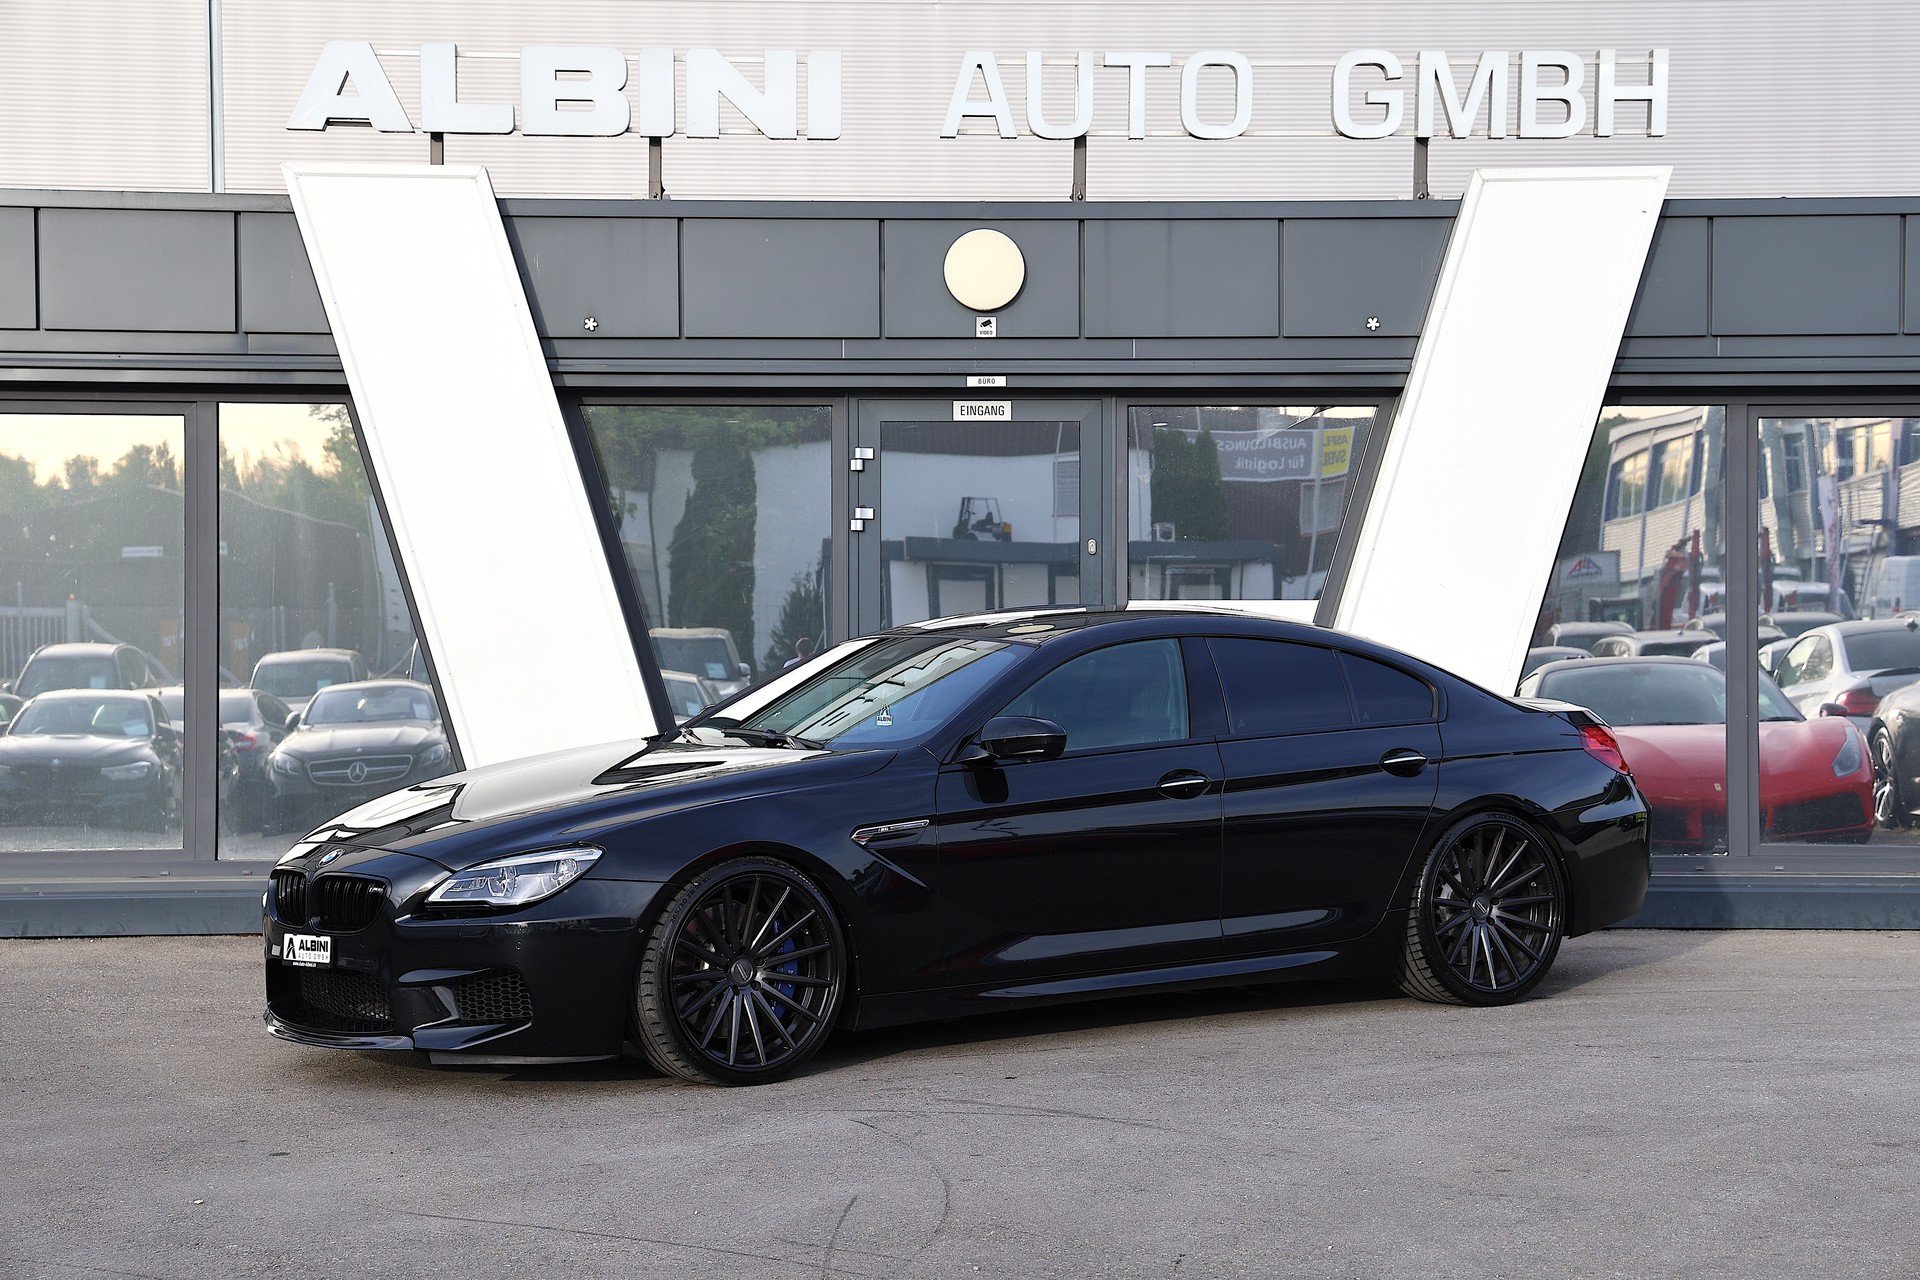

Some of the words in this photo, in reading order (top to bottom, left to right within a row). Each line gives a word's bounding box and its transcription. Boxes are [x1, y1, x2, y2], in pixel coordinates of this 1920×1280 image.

[285, 40, 842, 140] ALBINI
[940, 50, 1254, 140] AUTO
[1331, 48, 1670, 140] GMBH
[960, 405, 1005, 416] EINGANG
[299, 939, 329, 952] ALBINI
